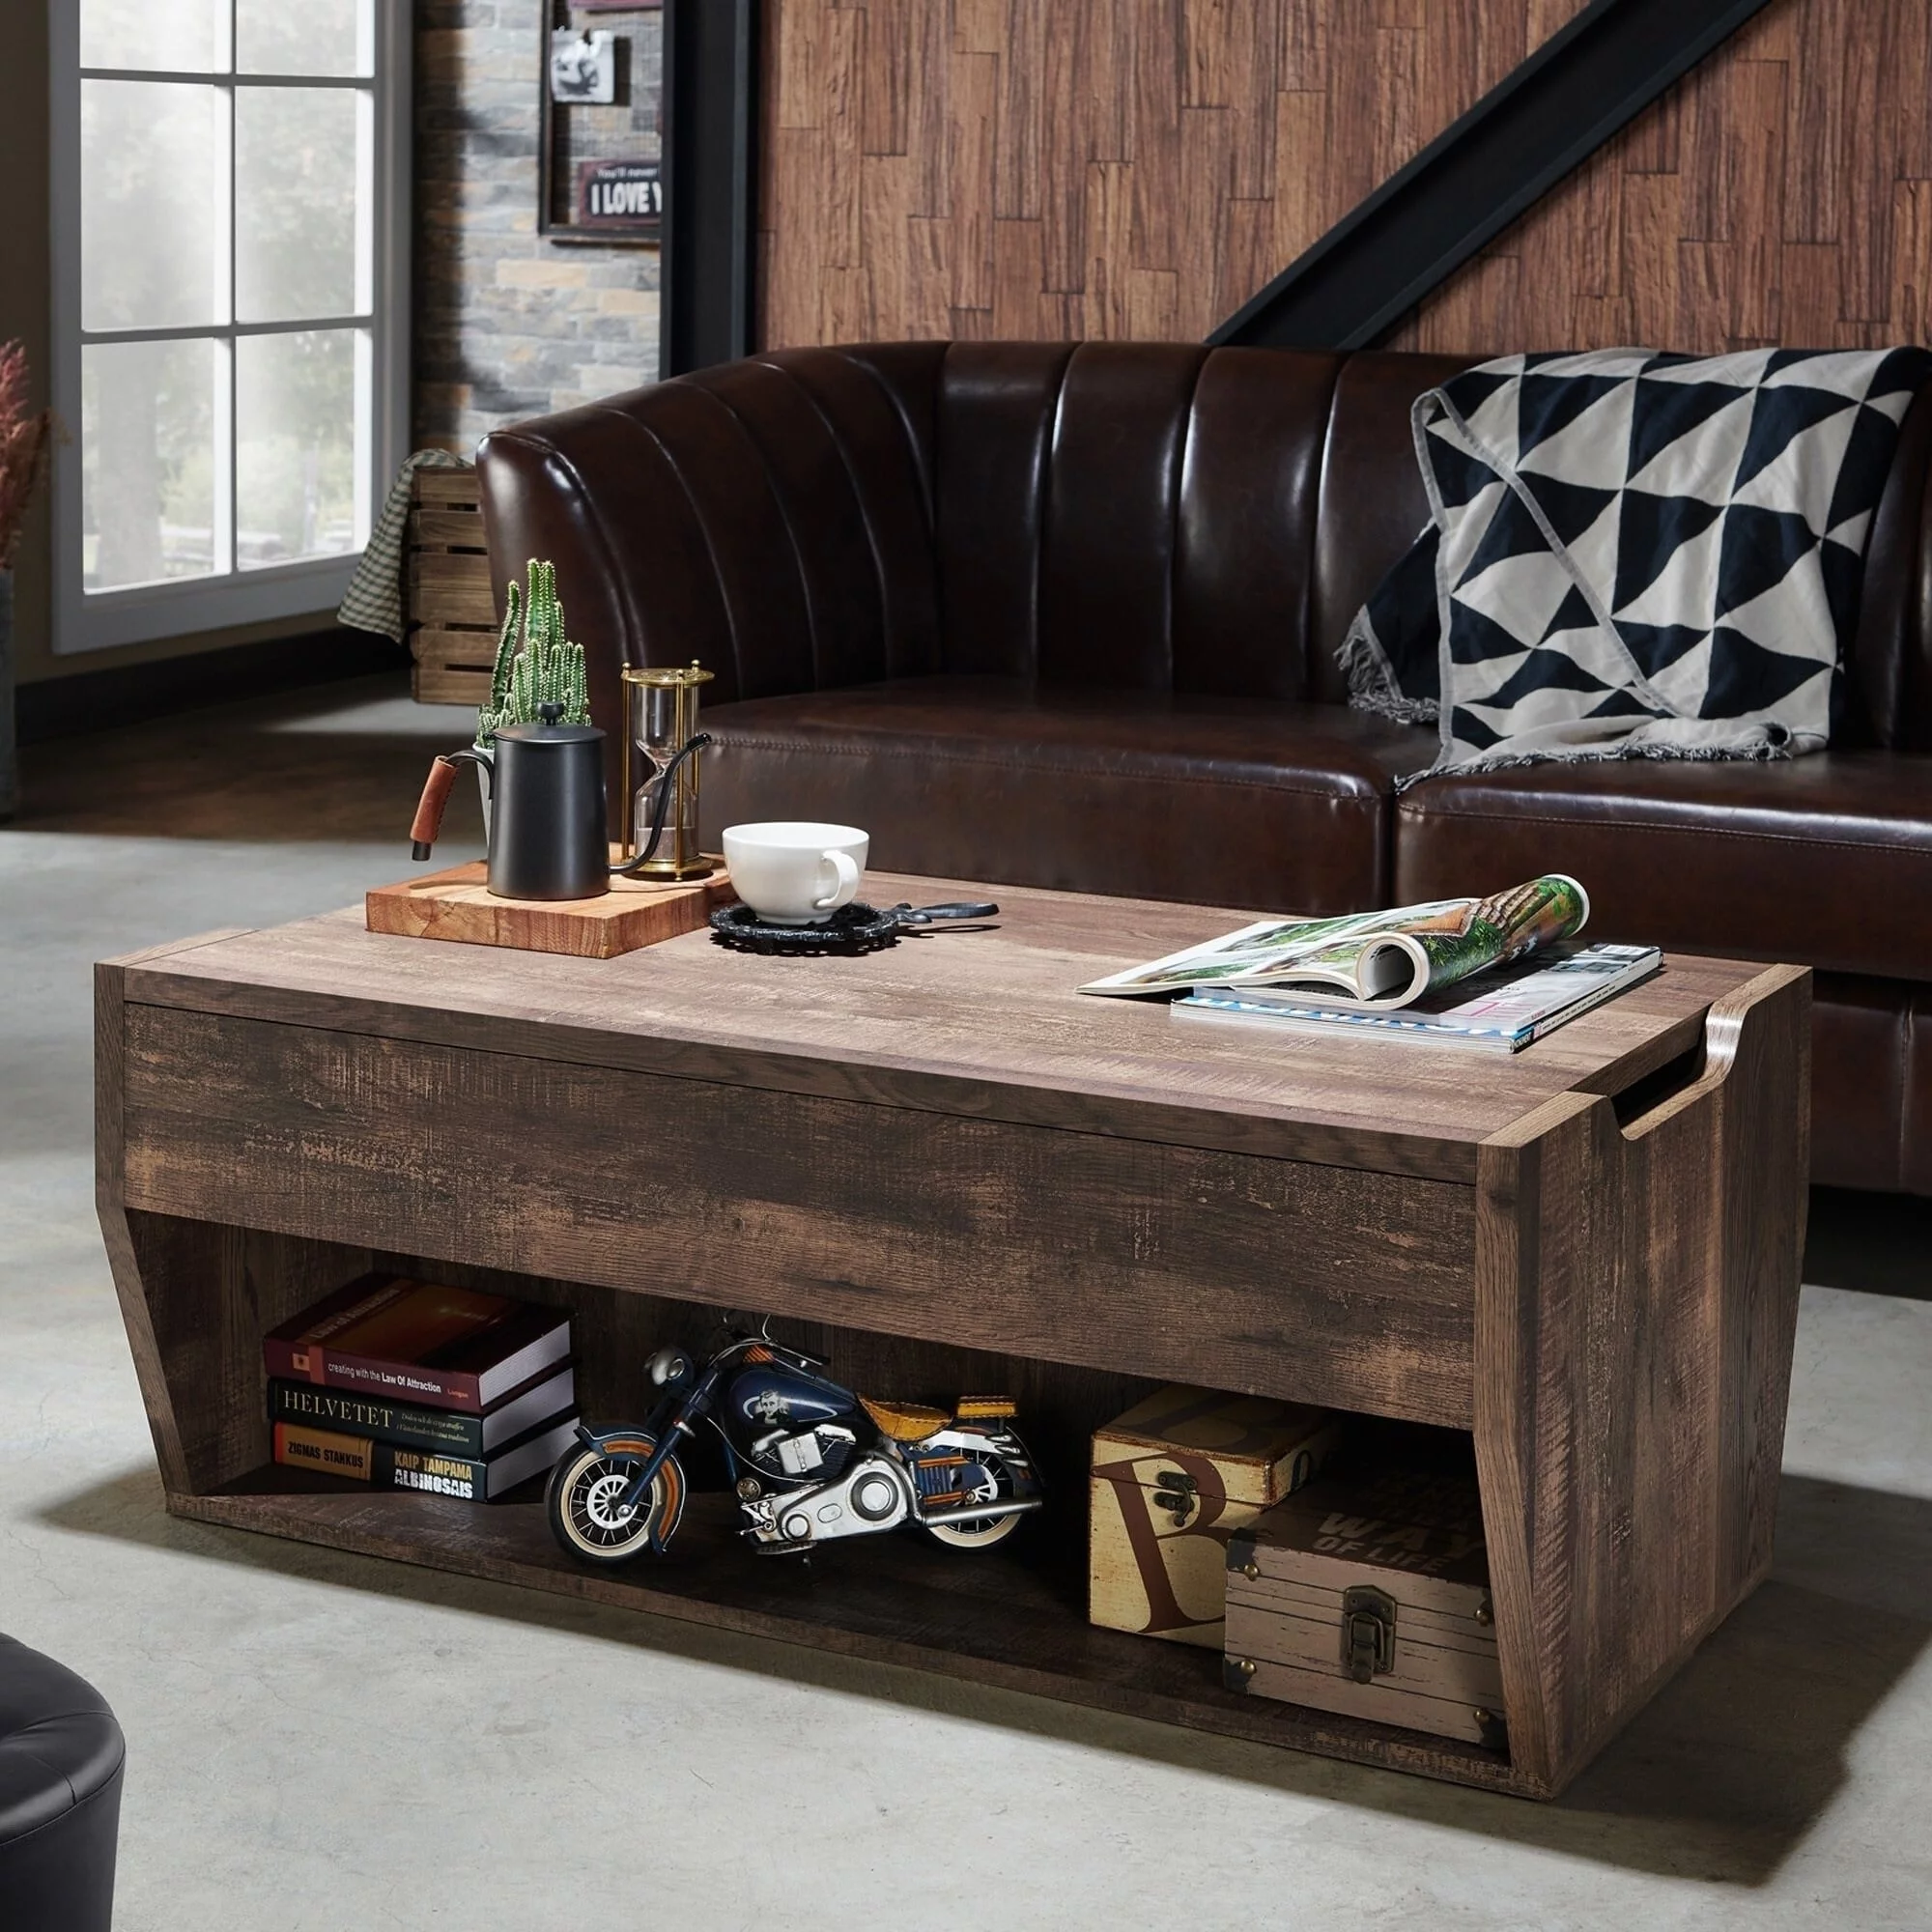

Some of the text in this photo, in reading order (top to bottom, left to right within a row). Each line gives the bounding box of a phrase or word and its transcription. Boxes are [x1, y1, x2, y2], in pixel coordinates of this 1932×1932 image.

[591, 183, 600, 215] I
[603, 182, 650, 214] LOVE
[327, 1362, 441, 1393] creating with the Law Of Attraction
[283, 1390, 394, 1430] HELVETET
[288, 1440, 364, 1469] ZIGMAS STANKUS
[394, 1450, 473, 1481] KAIP TAMPAMA
[394, 1467, 474, 1499] ALBINOSAIS
[1317, 1511, 1486, 1561] WAY
[1311, 1536, 1452, 1573] OF LIFE
